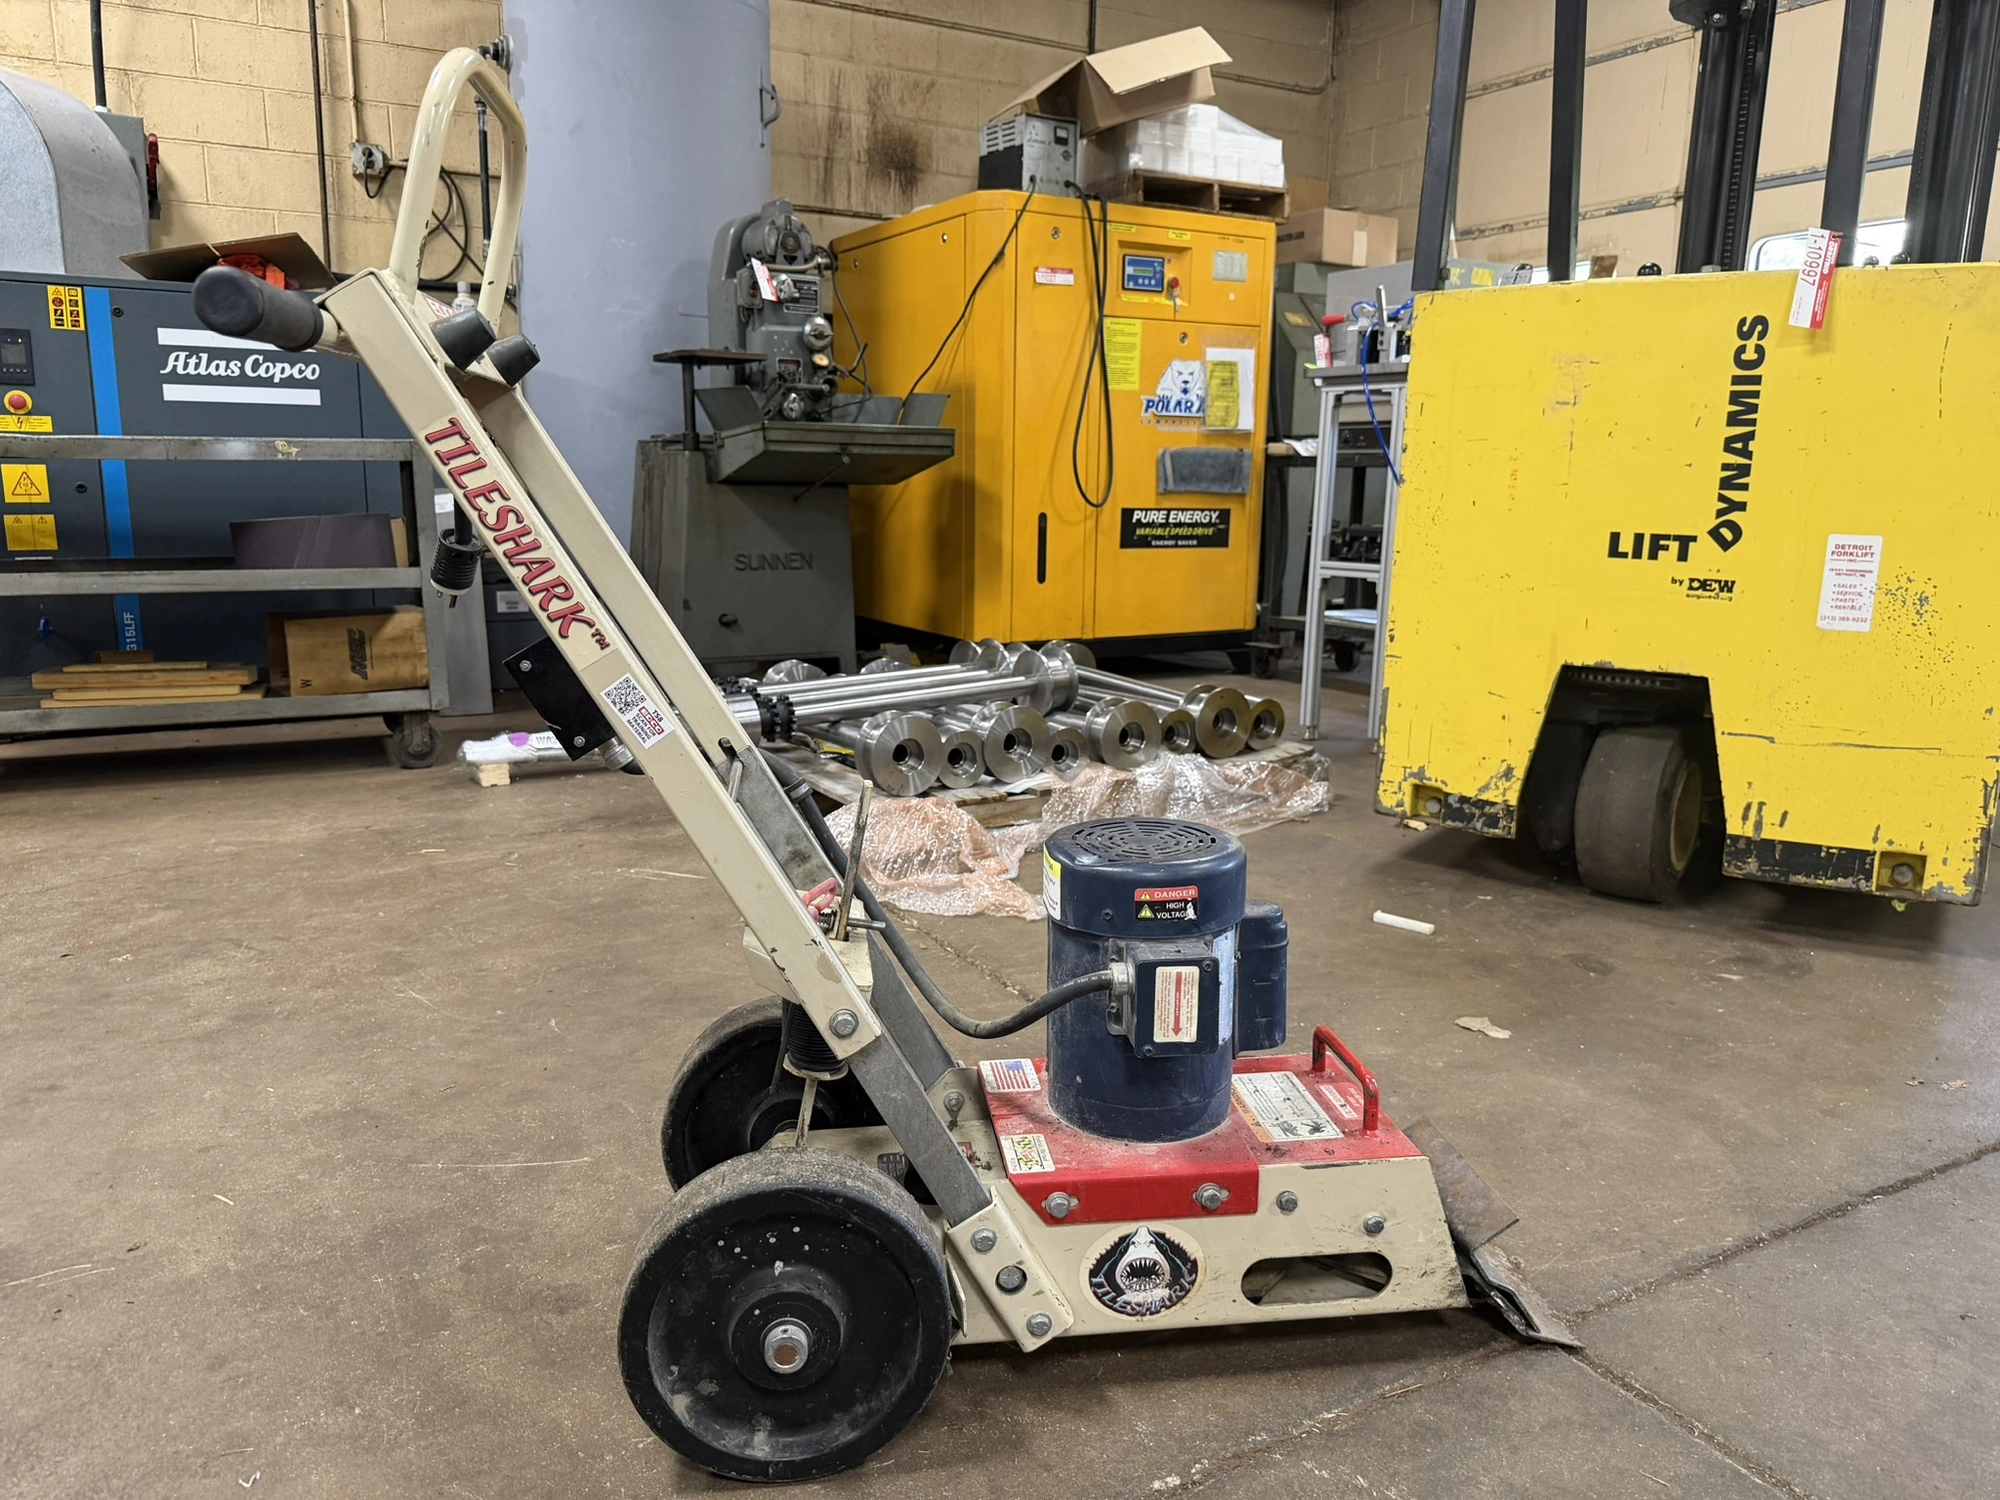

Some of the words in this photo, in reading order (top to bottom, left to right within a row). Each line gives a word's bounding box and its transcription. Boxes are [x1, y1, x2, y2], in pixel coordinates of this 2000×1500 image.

[1799, 233, 1826, 286] 1-10997
[159, 351, 242, 377] Atlas
[243, 354, 321, 383] Copco
[1143, 398, 1194, 414] POLAR
[1607, 531, 1698, 562] LIFT
[1706, 314, 1770, 553] DYNAMICS
[1132, 509, 1168, 524] PURE
[424, 416, 597, 640] TILESHARK
[1135, 527, 1170, 536] VARIABLE
[1170, 527, 1192, 536] SPEED
[1192, 527, 1214, 536] DRIVE
[1830, 551, 1876, 559] FORKLIFT
[1834, 543, 1874, 551] DETROIT
[734, 551, 813, 572] SUNNEN
[1670, 576, 1685, 587] by
[1686, 577, 1737, 594] DEW
[626, 718, 648, 744] MATERIAL
[631, 716, 652, 740] TRAINING
[635, 712, 648, 727] SCAN
[647, 725, 657, 737] FOR
[639, 707, 665, 735] EDCO
[1154, 889, 1196, 899] DANGER
[1156, 910, 1189, 919] VOLTAG
[1166, 901, 1185, 909] HIGH
[1090, 1272, 1197, 1314] TILESHARK
